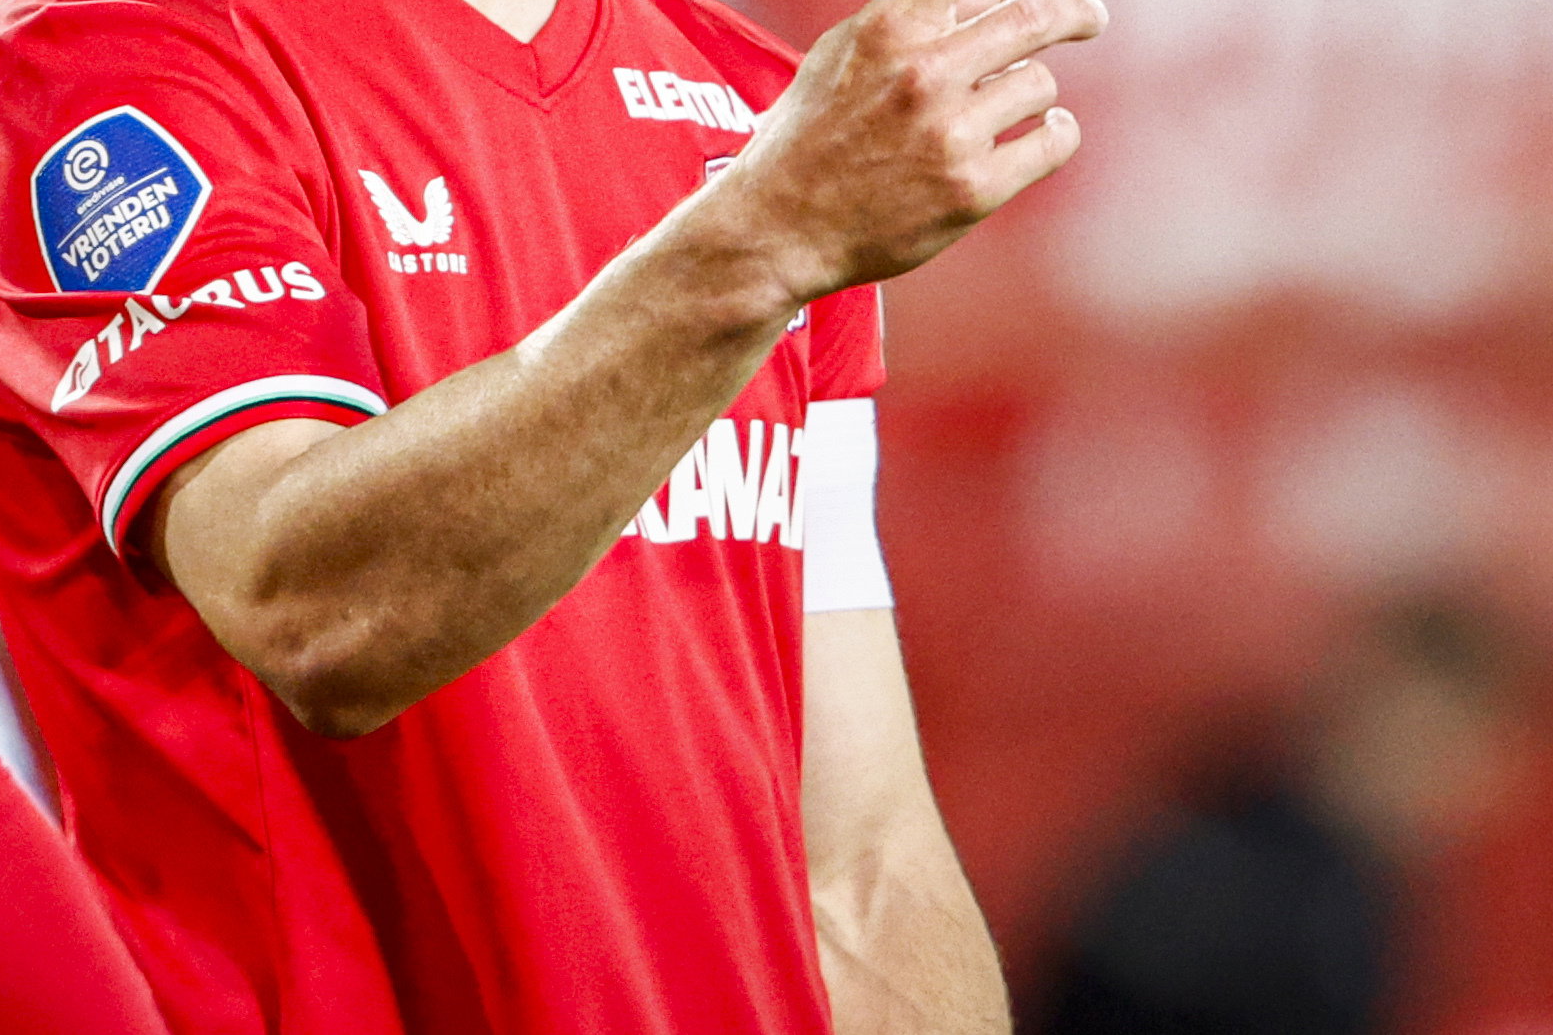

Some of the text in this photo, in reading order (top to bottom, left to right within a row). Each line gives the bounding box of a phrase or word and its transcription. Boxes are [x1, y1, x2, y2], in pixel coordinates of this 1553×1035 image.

[61, 176, 179, 267] VRIENDEN
[82, 204, 171, 282] LOTERIJ
[98, 261, 326, 364] TAURUS
